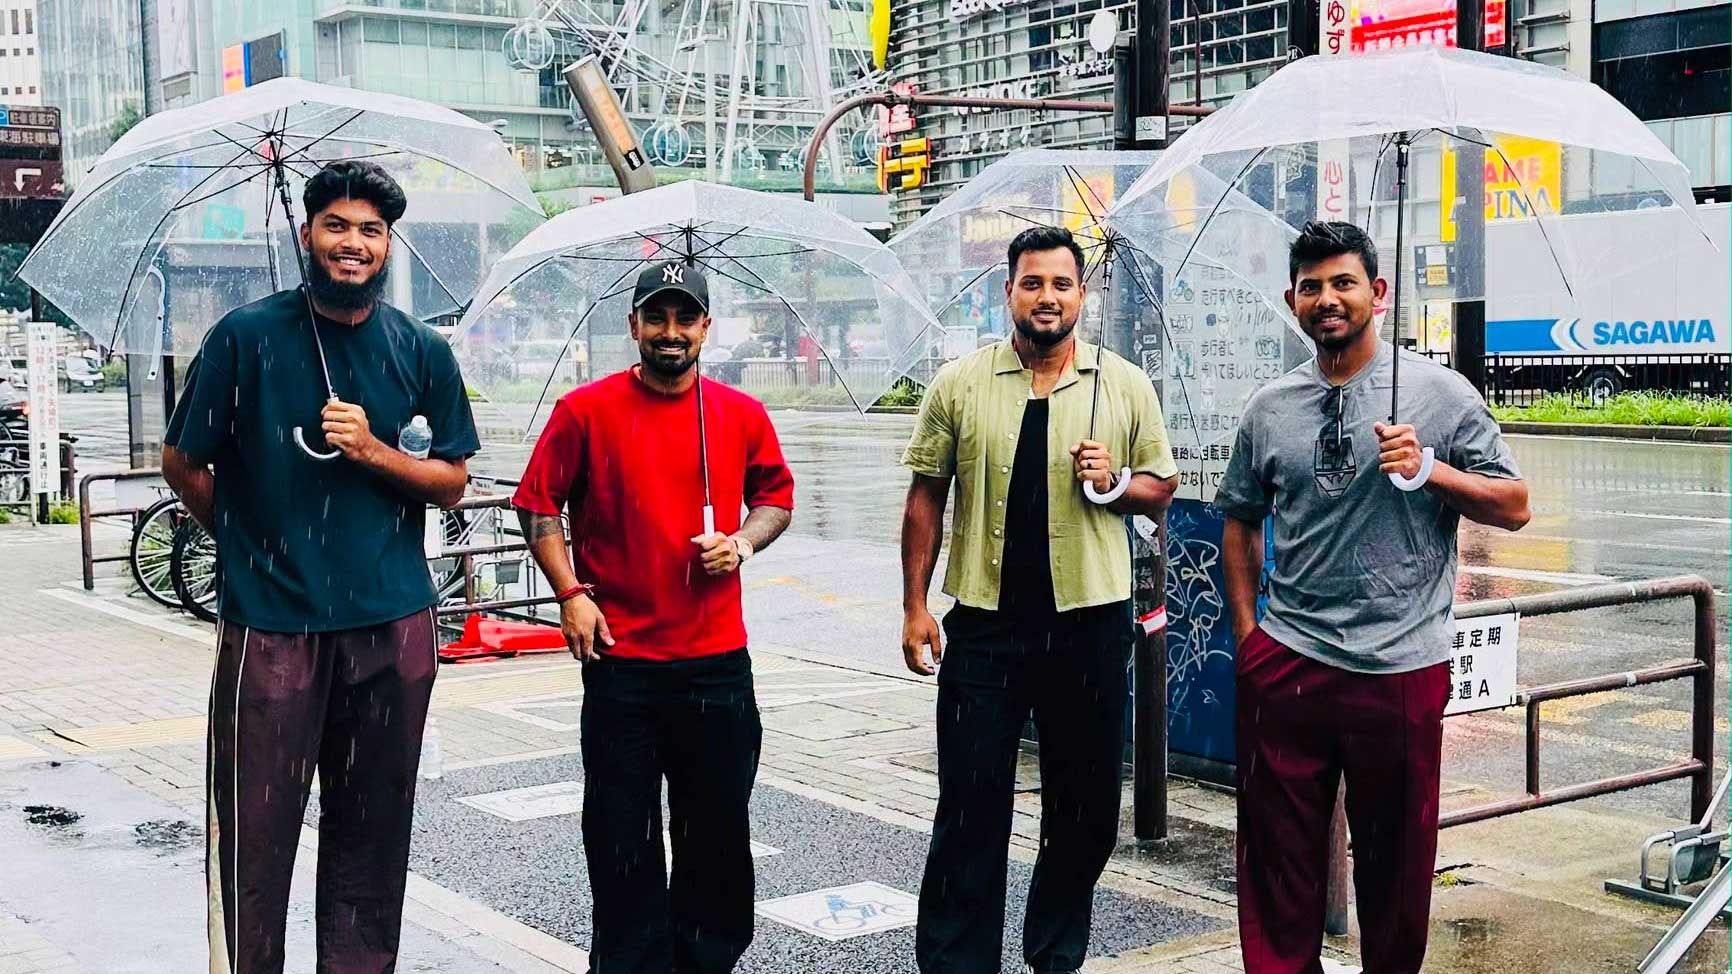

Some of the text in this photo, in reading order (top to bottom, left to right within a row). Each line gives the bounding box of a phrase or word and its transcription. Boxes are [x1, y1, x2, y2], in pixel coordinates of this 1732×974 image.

[1327, 2, 1346, 54] ゆず
[1484, 155, 1541, 184] AME
[1324, 160, 1344, 222] 心と
[662, 263, 684, 284] NY
[1593, 319, 1716, 345] SAGAWA
[1171, 445, 1233, 461] 道路に自転車
[1179, 470, 1225, 488] かないで
[1452, 626, 1502, 651] 車定期
